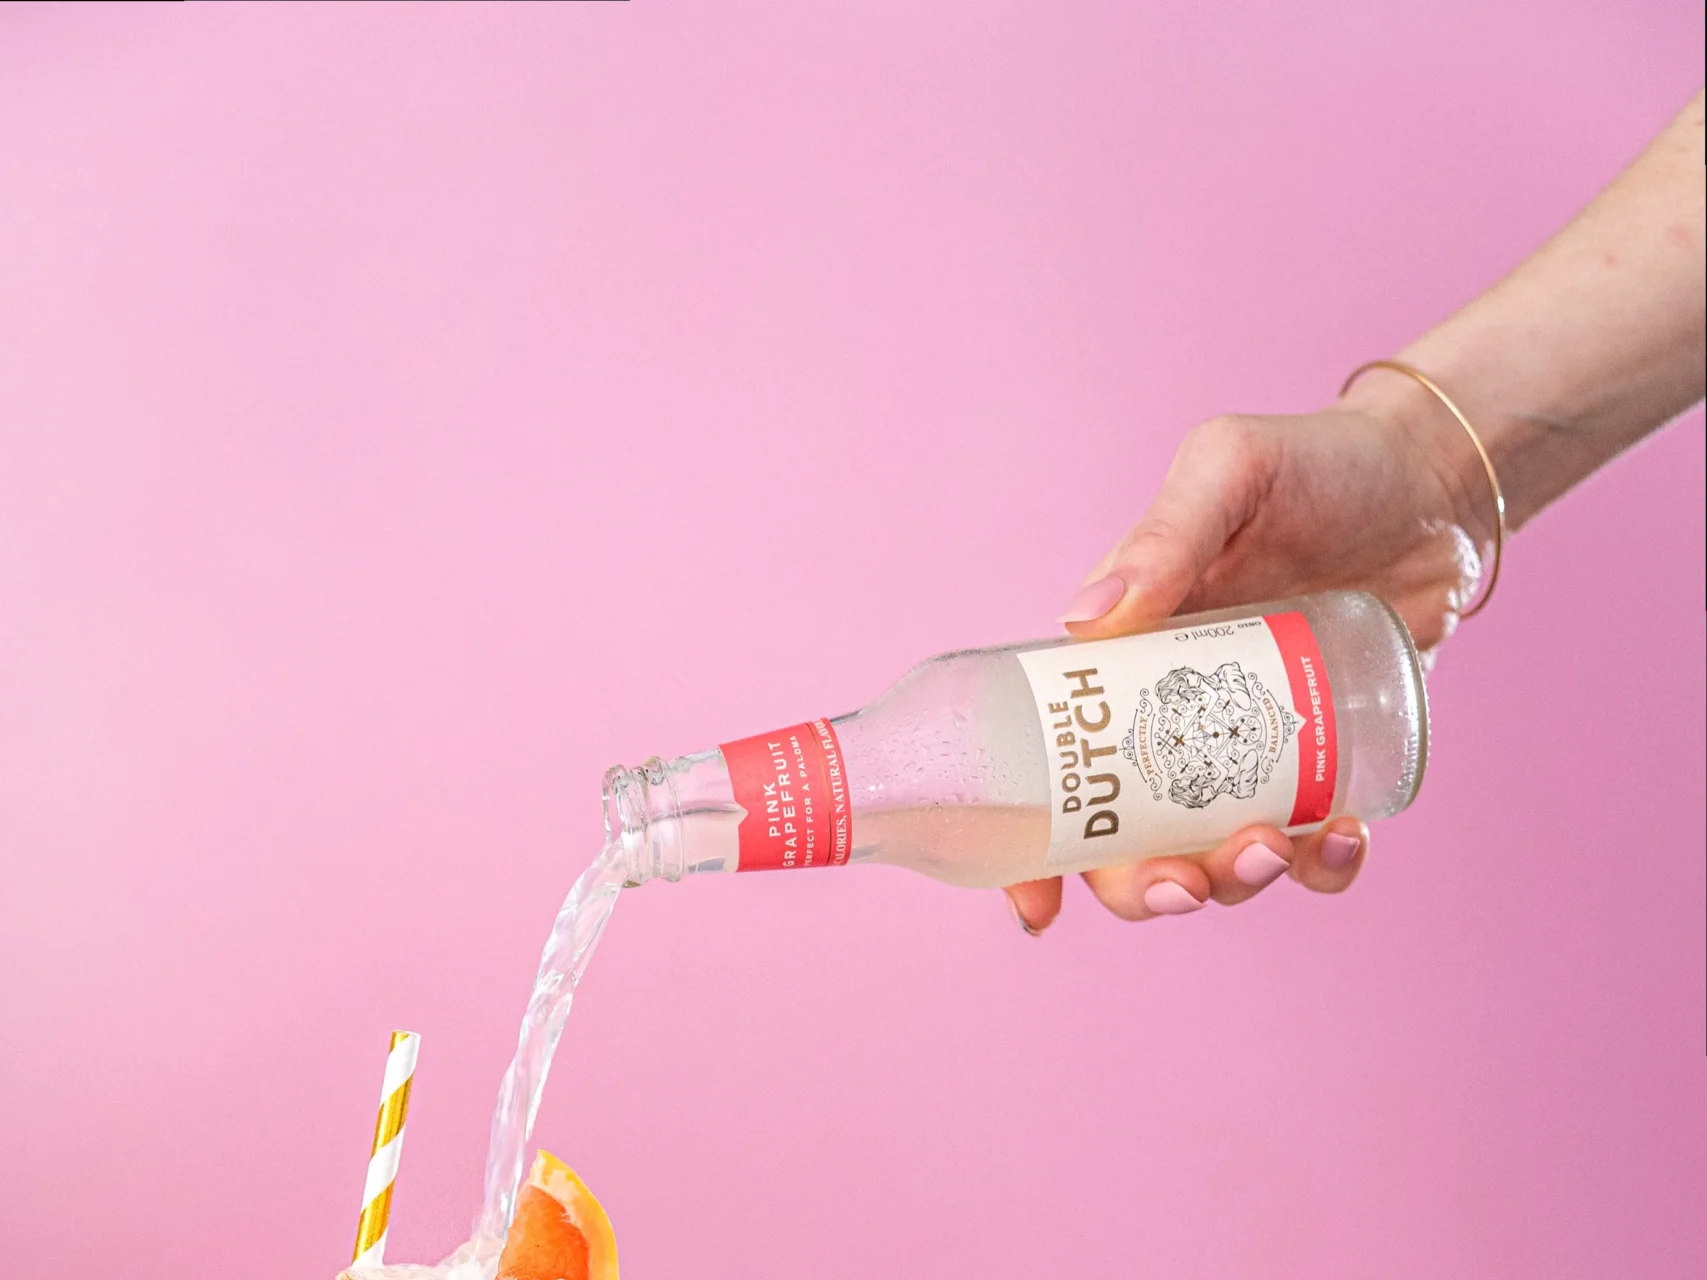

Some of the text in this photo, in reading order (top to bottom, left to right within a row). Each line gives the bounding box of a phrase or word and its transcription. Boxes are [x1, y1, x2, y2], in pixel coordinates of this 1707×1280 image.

[1191, 625, 1235, 641] 200ml
[1048, 701, 1082, 814] DOUBLE
[1063, 667, 1120, 839] DUTCH
[1139, 715, 1155, 776] PERFECTLY
[1262, 698, 1277, 753] BALANCED
[1301, 656, 1325, 783] PINK GRAPEFRUIT
[763, 781, 781, 837] PINK
[768, 741, 797, 868] GRAPEFRUIT
[789, 735, 815, 867] PERFECT FOR A PALOMA
[826, 750, 845, 813] NATURAL
